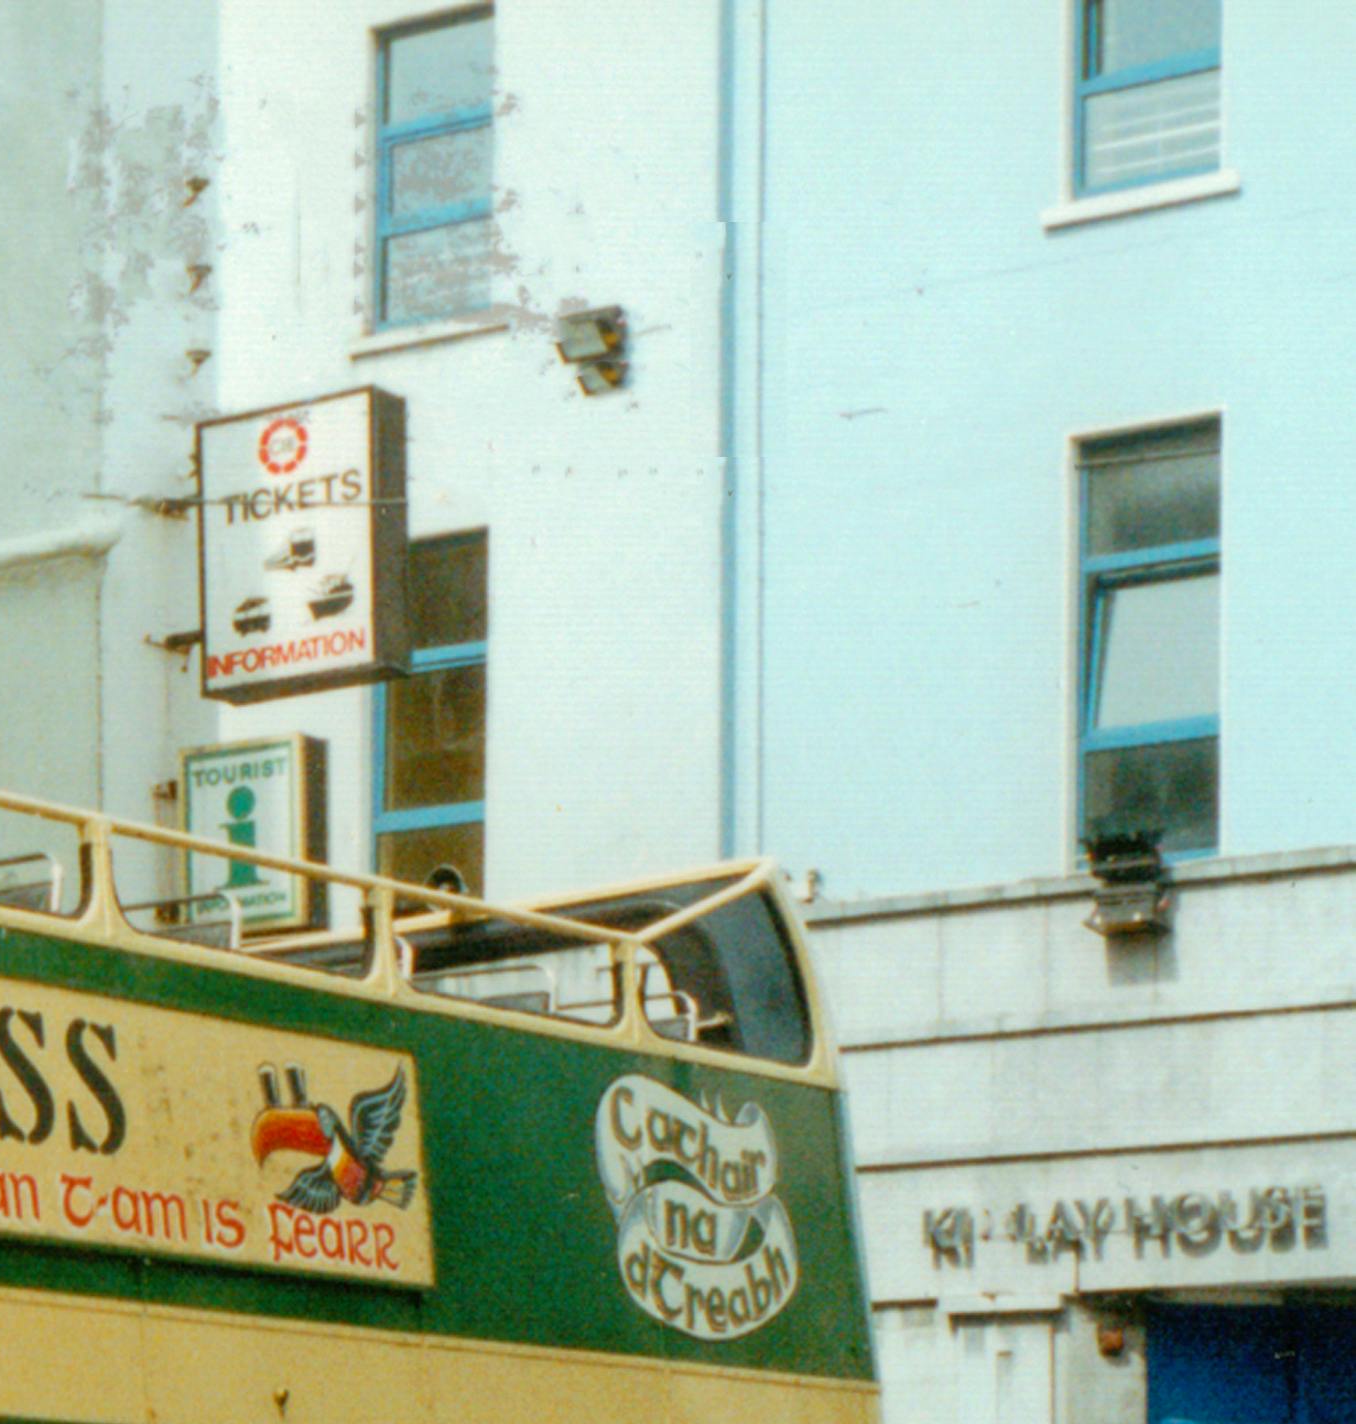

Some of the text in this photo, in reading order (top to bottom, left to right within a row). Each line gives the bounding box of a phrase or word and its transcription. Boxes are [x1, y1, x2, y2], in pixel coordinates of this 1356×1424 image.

[219, 468, 363, 524] TICKETS
[206, 627, 365, 678] INFORMATION
[193, 758, 286, 787] TOURIST
[663, 1198, 718, 1258] na
